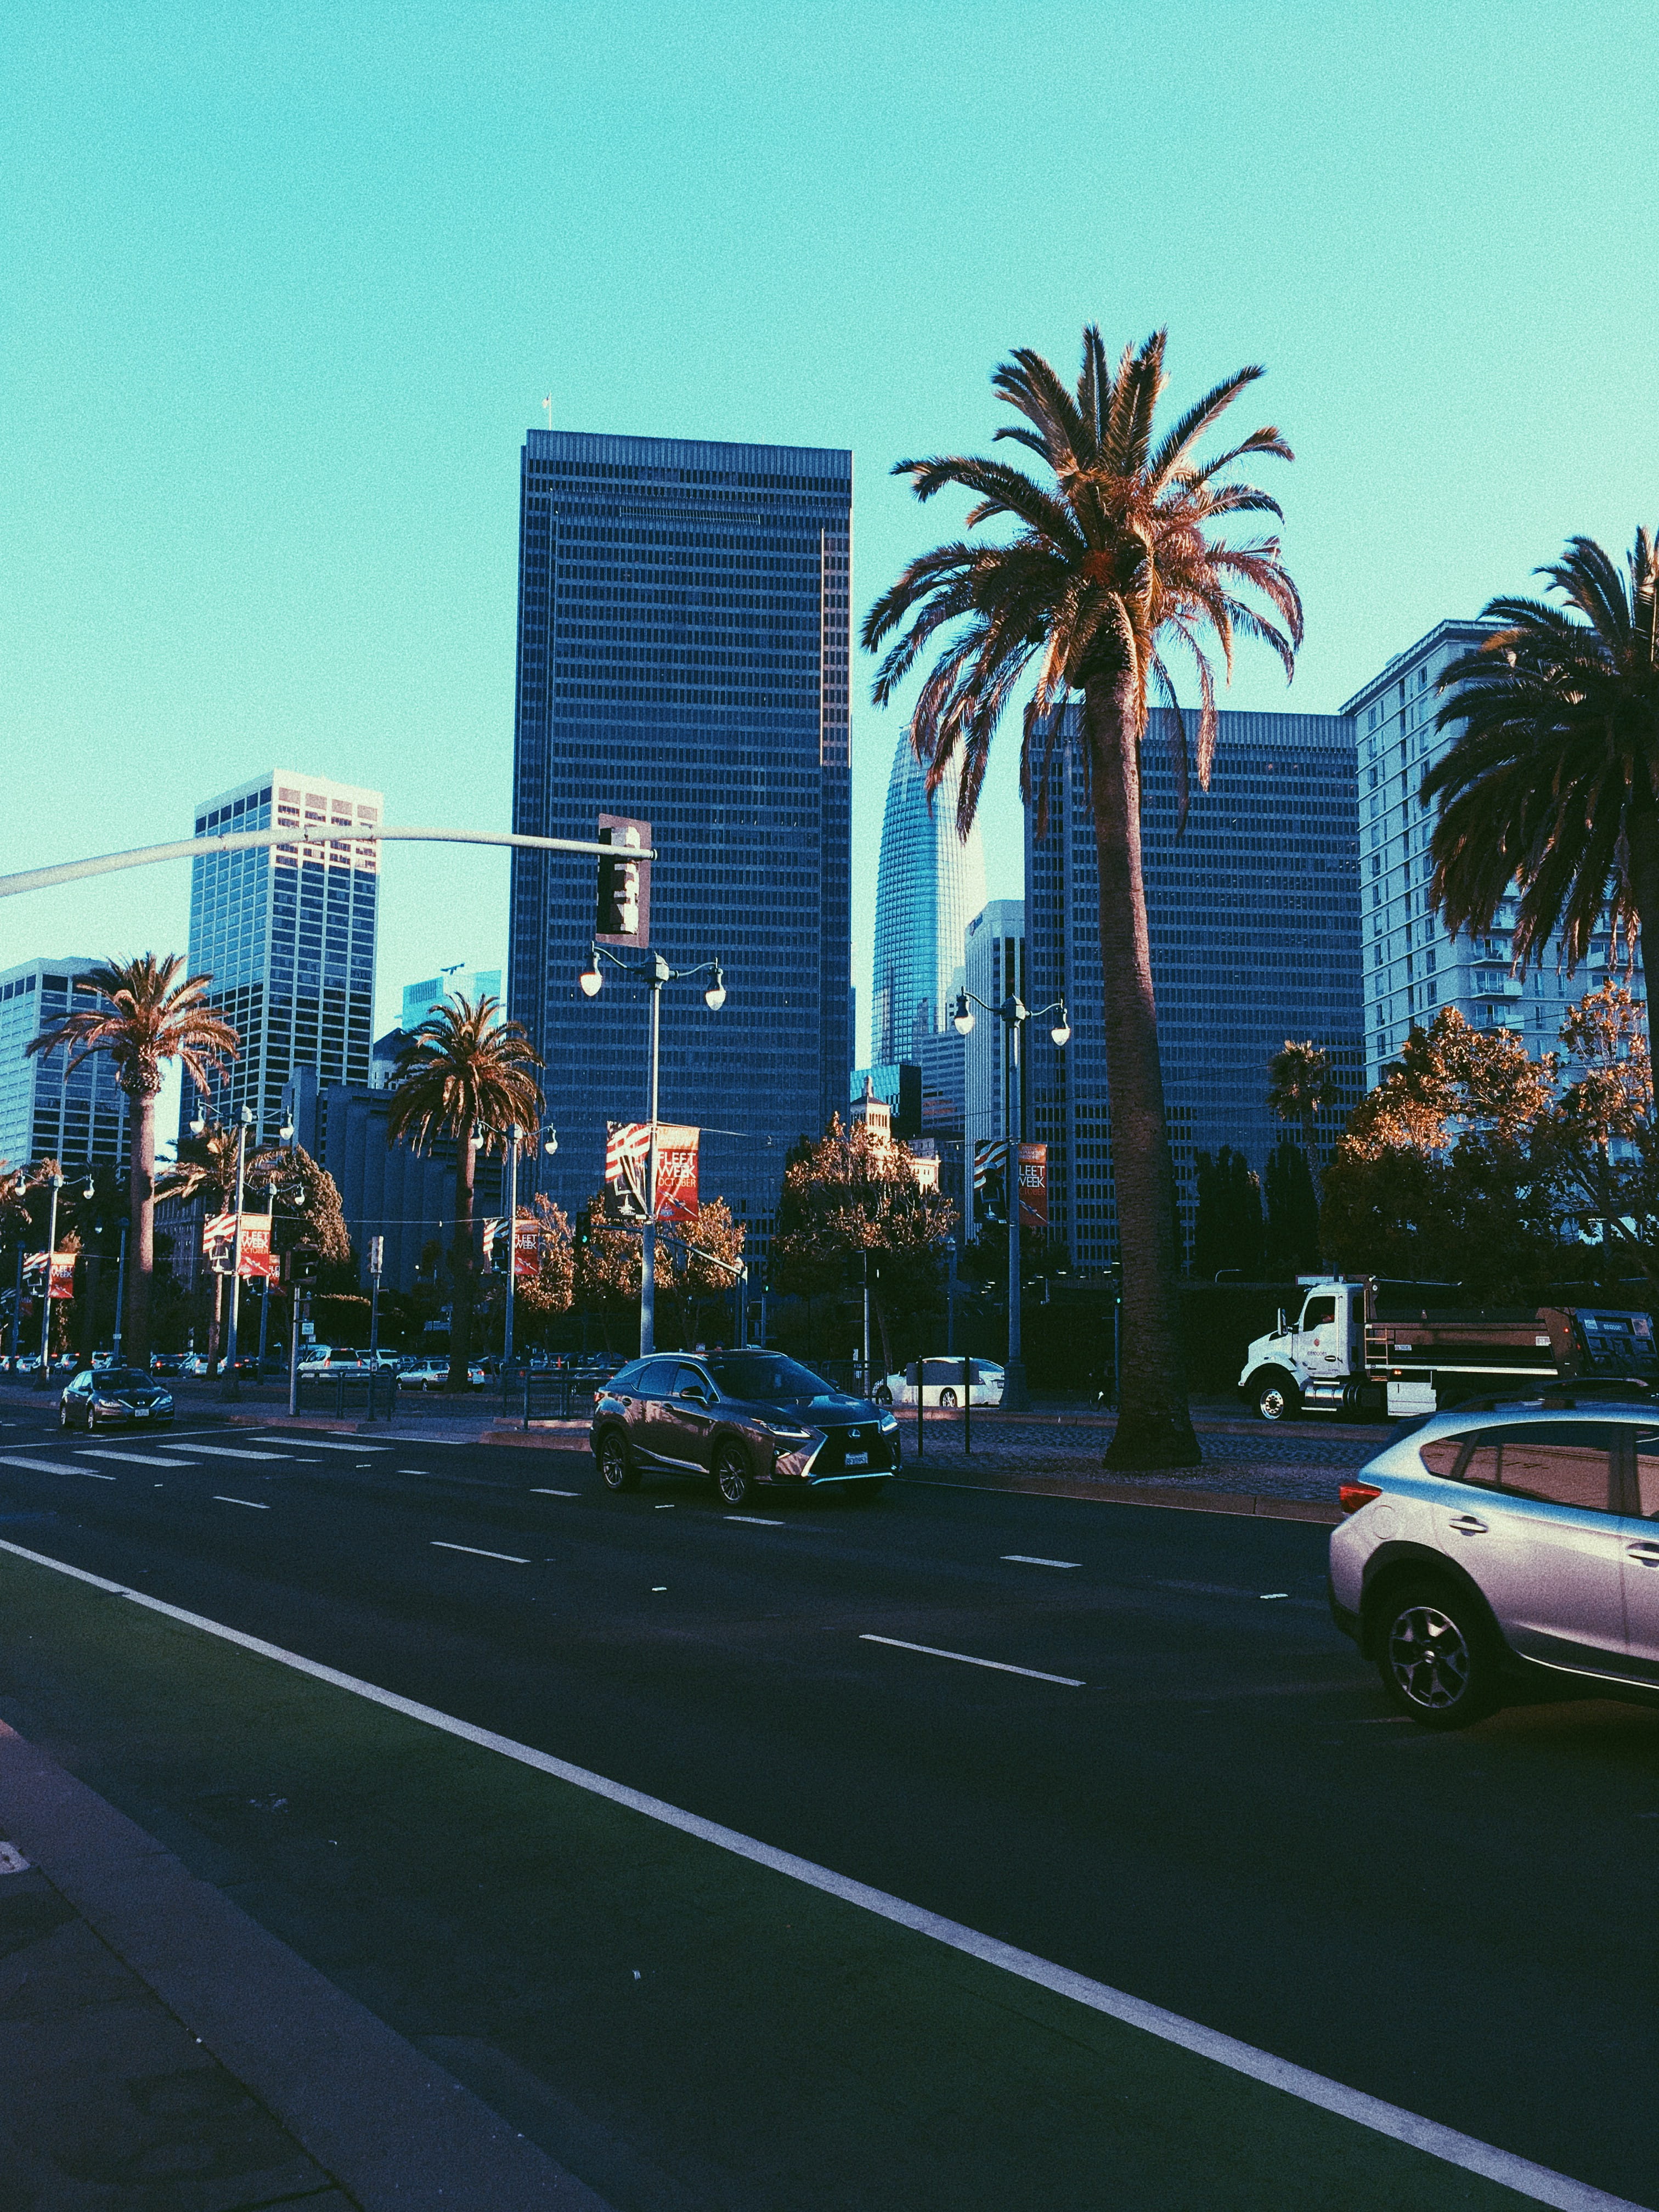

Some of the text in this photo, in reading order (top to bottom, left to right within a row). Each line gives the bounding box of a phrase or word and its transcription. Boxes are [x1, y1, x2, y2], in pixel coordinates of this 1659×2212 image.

[658, 1152, 696, 1166] FLEET
[658, 1165, 696, 1178] WEEK
[1019, 1165, 1045, 1177] LEET
[658, 1178, 696, 1187] OCTOBER
[241, 1231, 269, 1240] FLEET
[241, 1239, 268, 1248] WEEK
